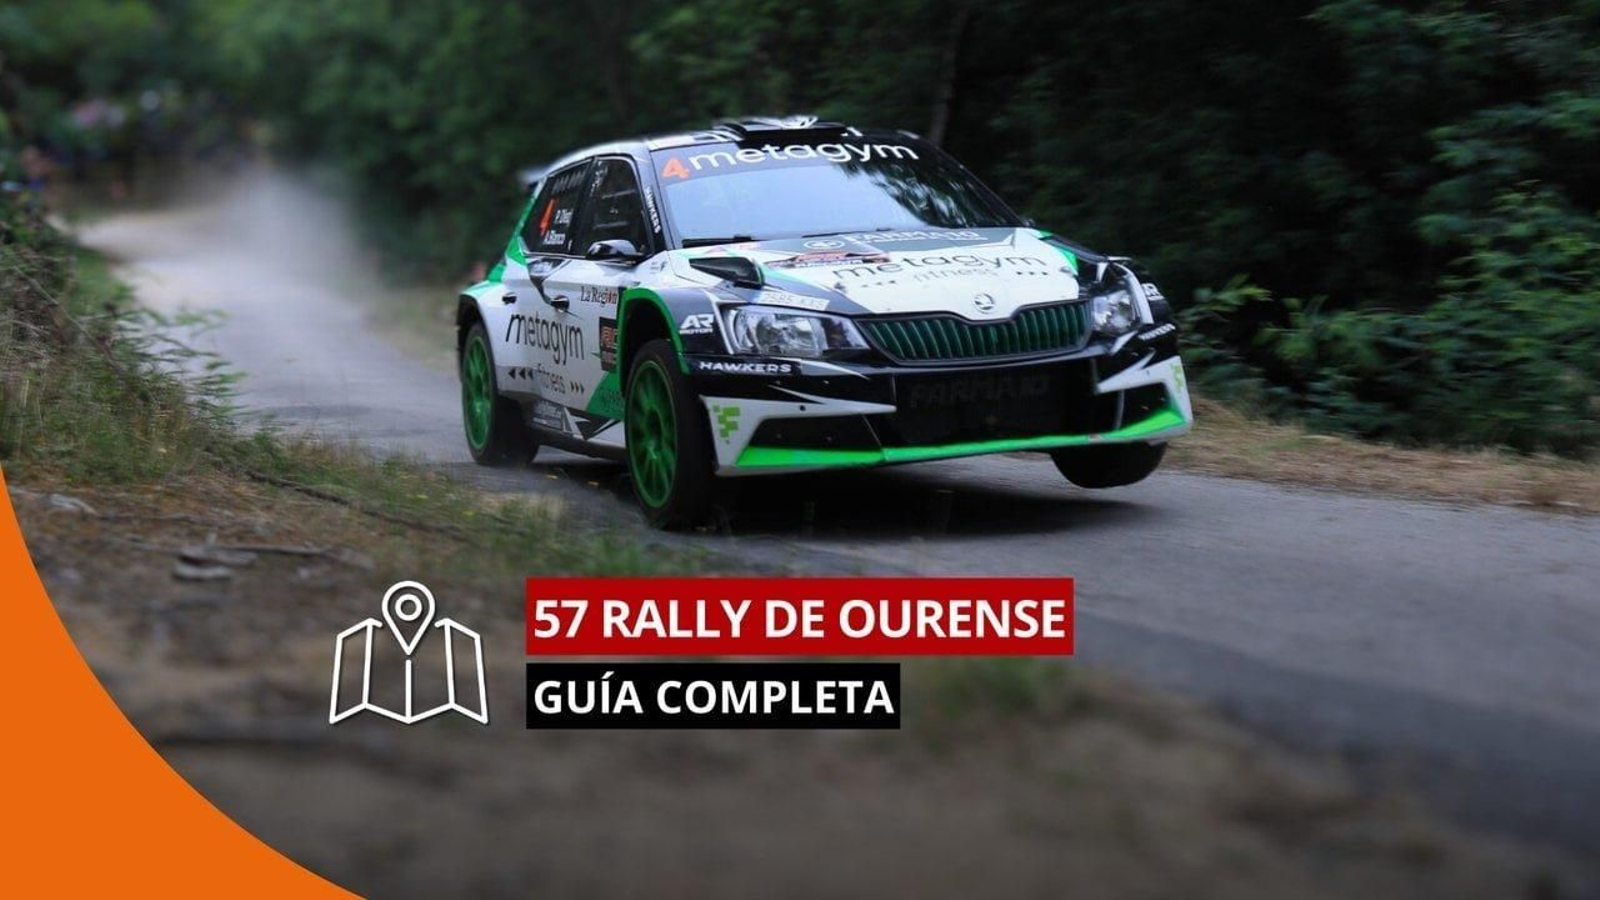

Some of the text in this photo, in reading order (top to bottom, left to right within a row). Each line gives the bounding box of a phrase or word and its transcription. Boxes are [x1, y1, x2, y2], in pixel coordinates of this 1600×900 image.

[661, 142, 919, 180] 4 metagym
[539, 199, 558, 237] 4
[832, 255, 1047, 280] metagym
[505, 311, 585, 366] metagym
[700, 361, 792, 374] HAWKERS
